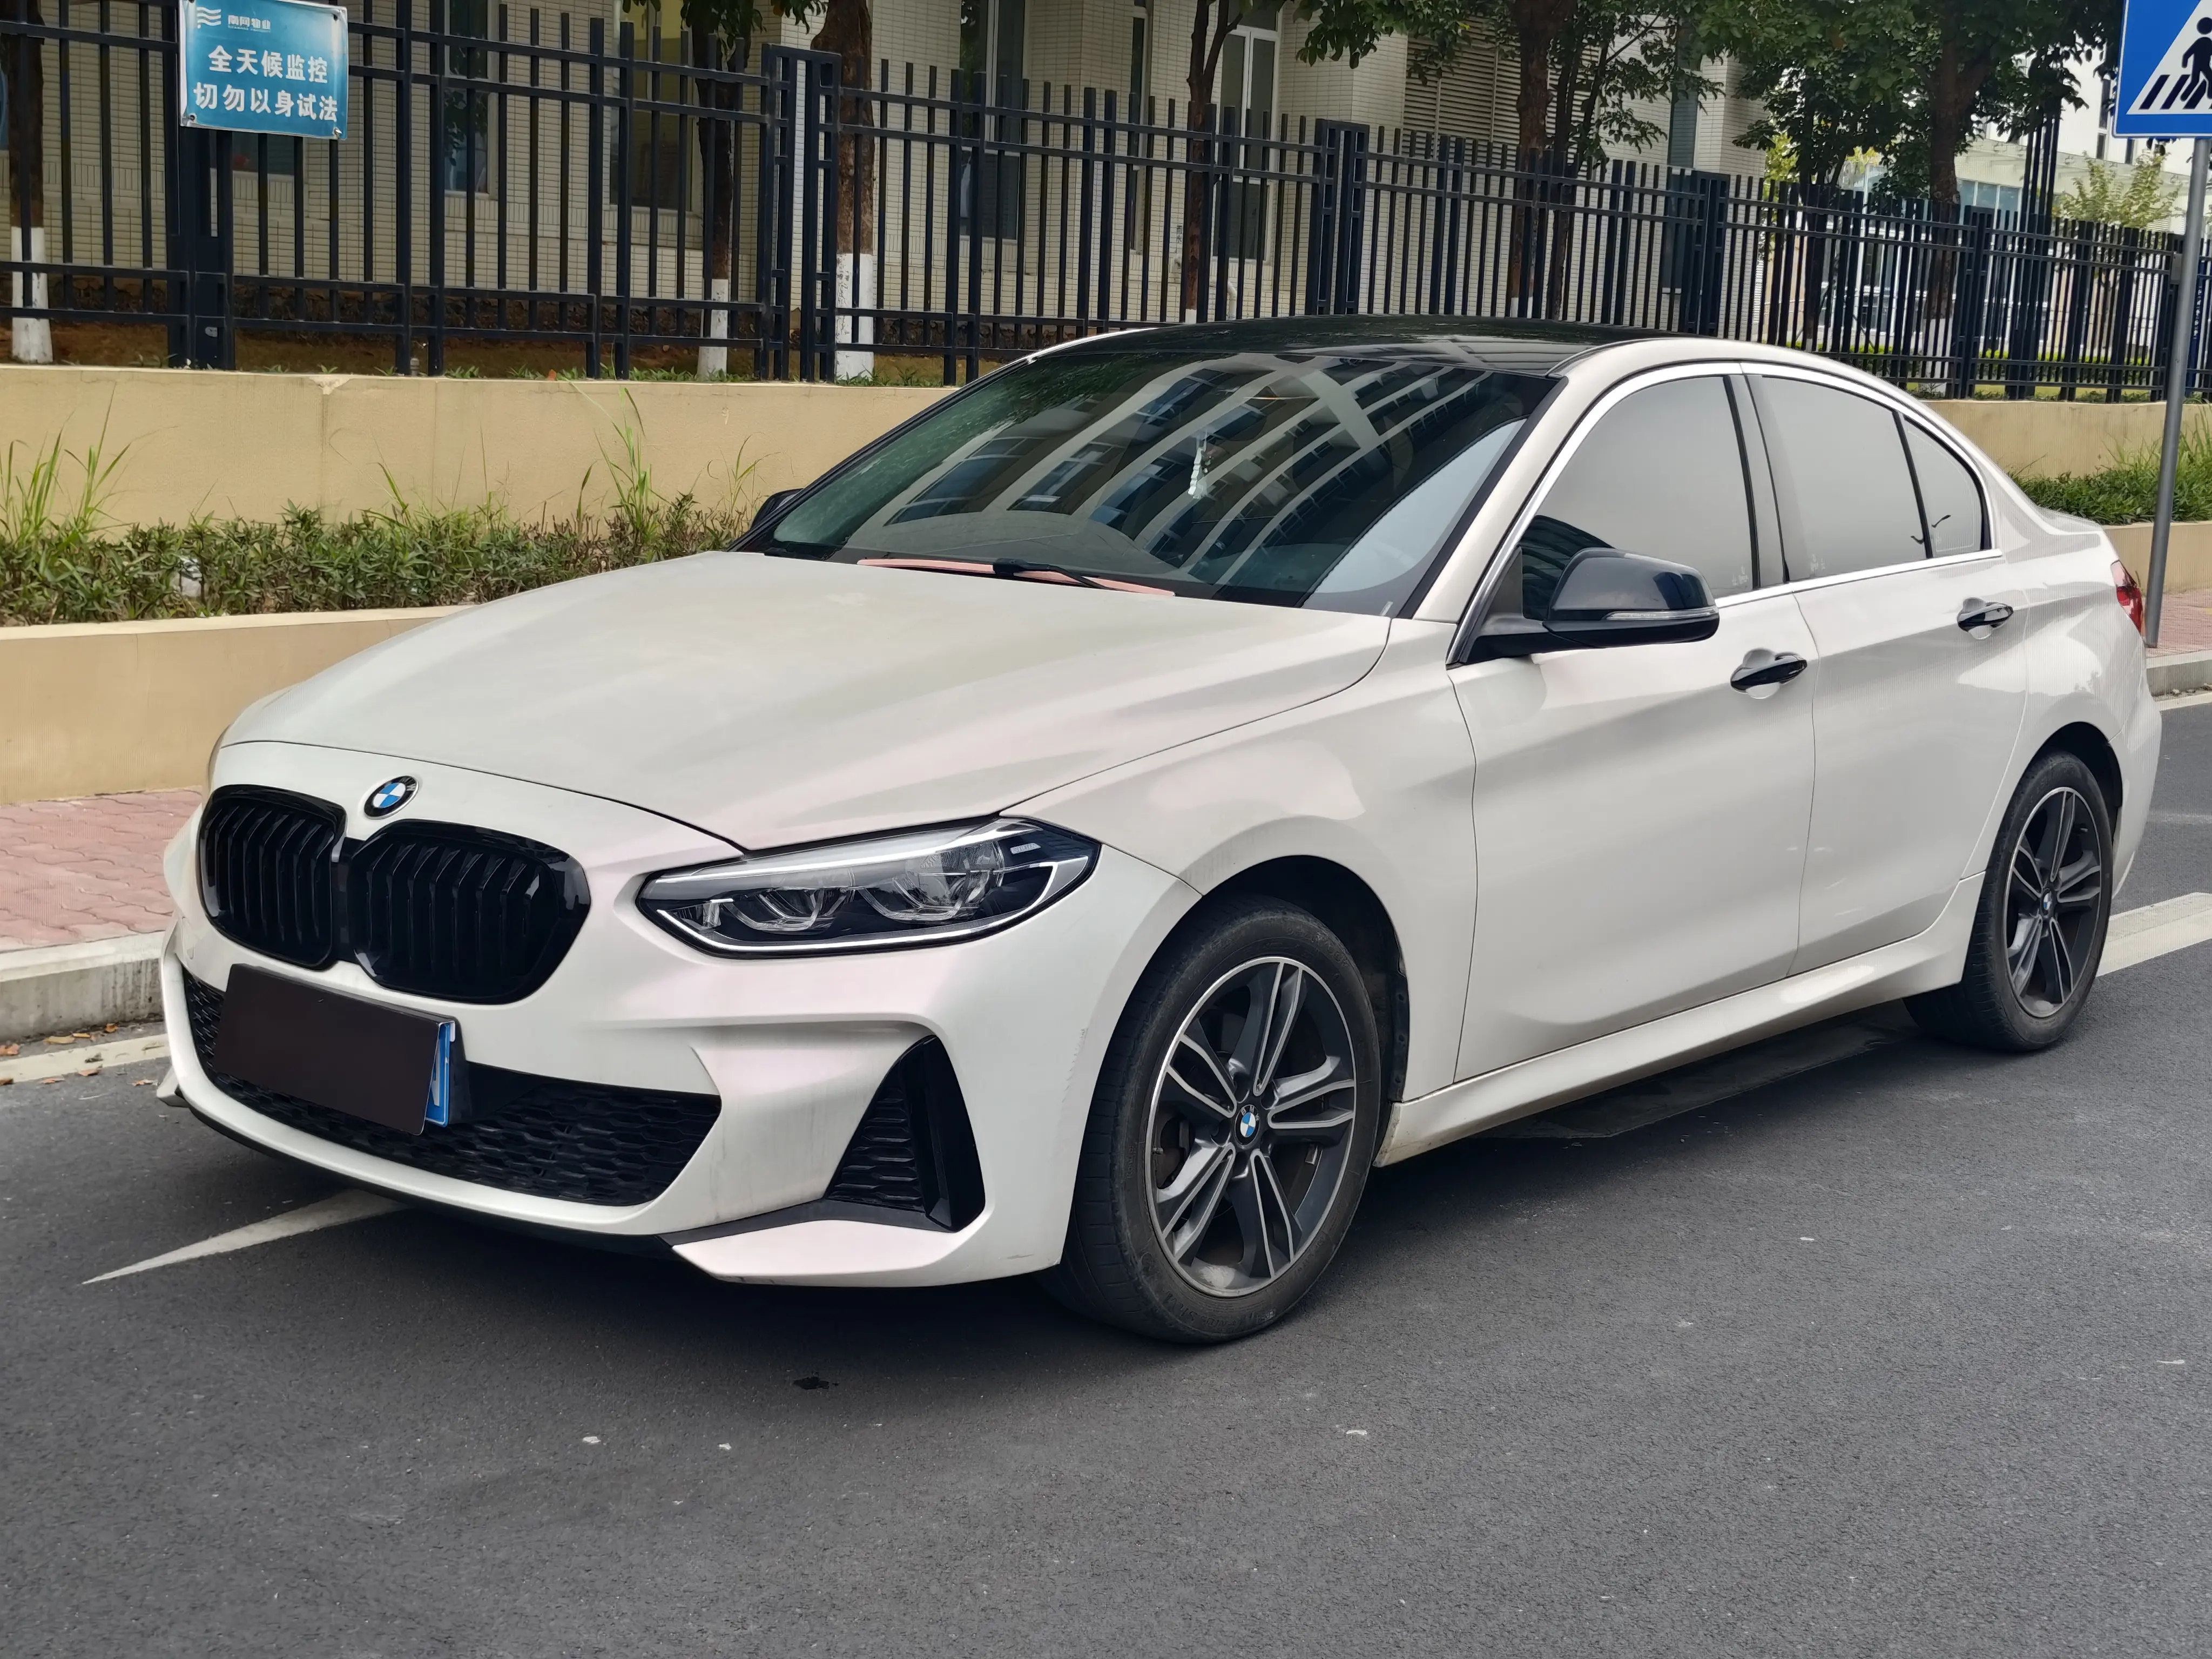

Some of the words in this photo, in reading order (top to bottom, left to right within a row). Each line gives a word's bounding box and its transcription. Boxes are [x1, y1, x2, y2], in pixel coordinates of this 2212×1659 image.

[208, 45, 328, 83] 全天候监控
[193, 82, 338, 123] 切勿以身试法
[1241, 1105, 1260, 1122] BMW
